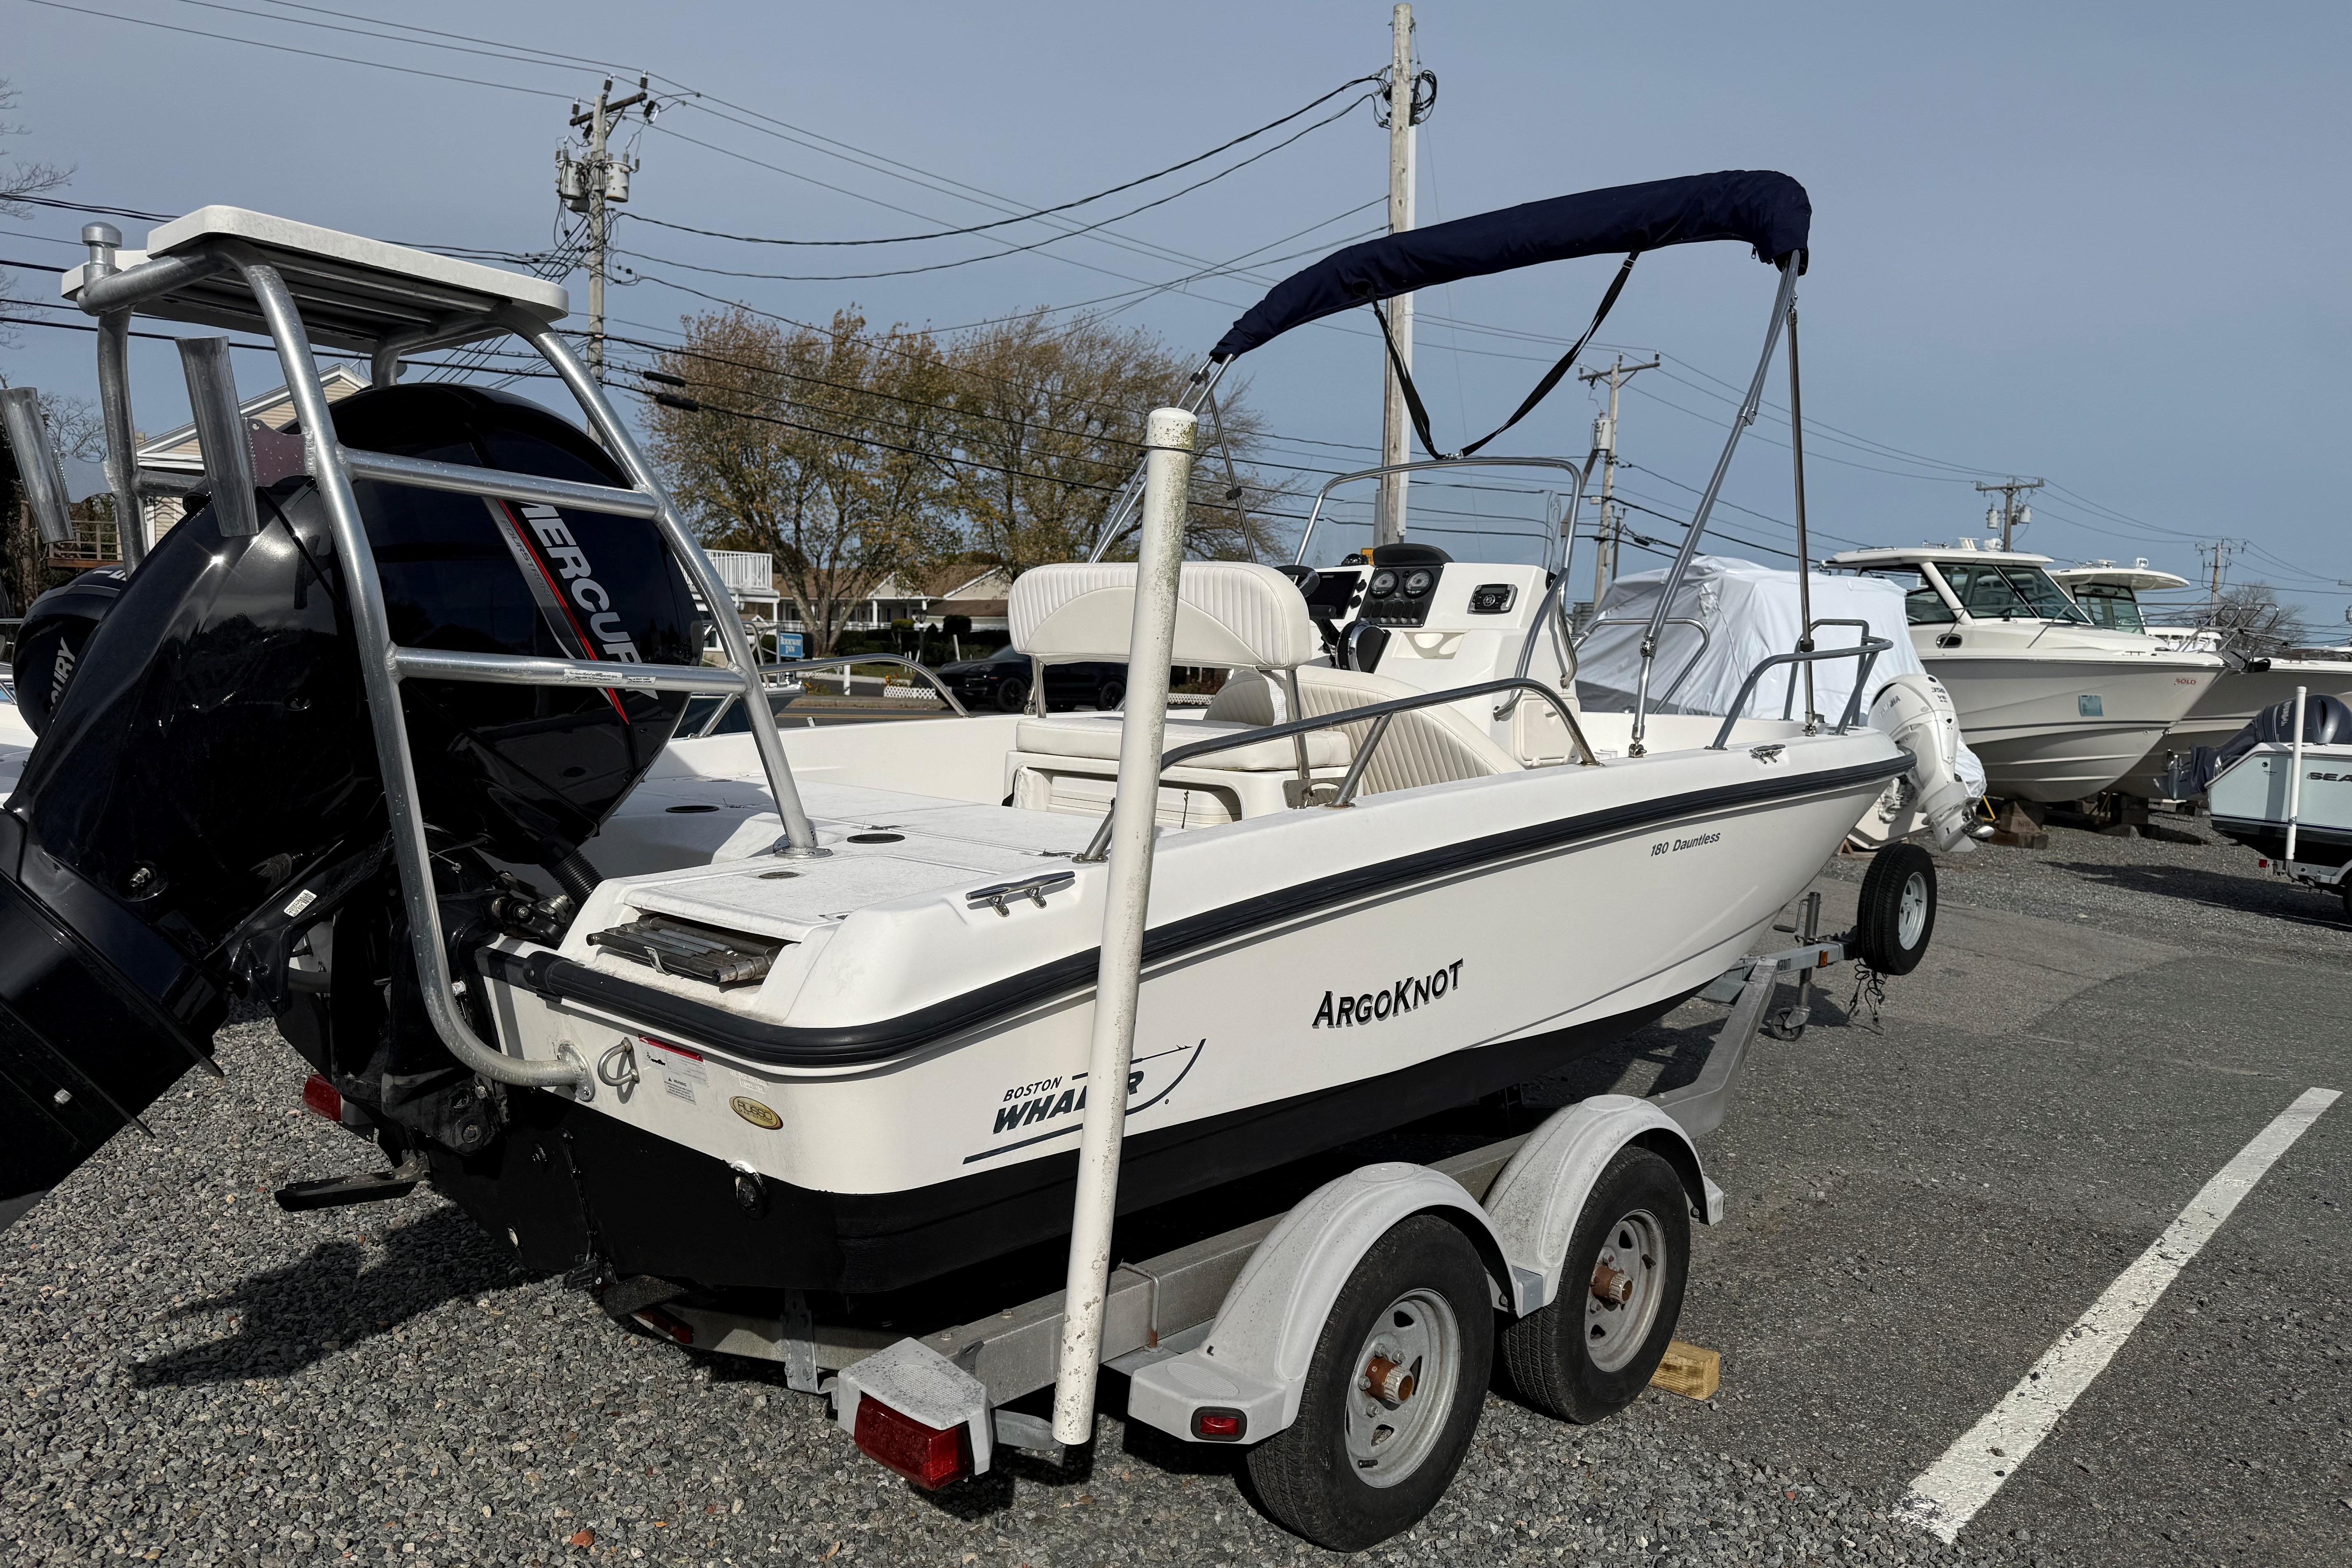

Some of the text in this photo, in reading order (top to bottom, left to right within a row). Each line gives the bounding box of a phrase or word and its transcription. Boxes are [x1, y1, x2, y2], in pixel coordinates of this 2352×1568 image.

[501, 519, 554, 601] FOURSTROKE
[1878, 695, 1901, 719] YAMAHA
[1651, 832, 1721, 857] 180 Dauntless
[1003, 1076, 1063, 1102] BOSTON
[737, 1100, 772, 1120] RUSSO
